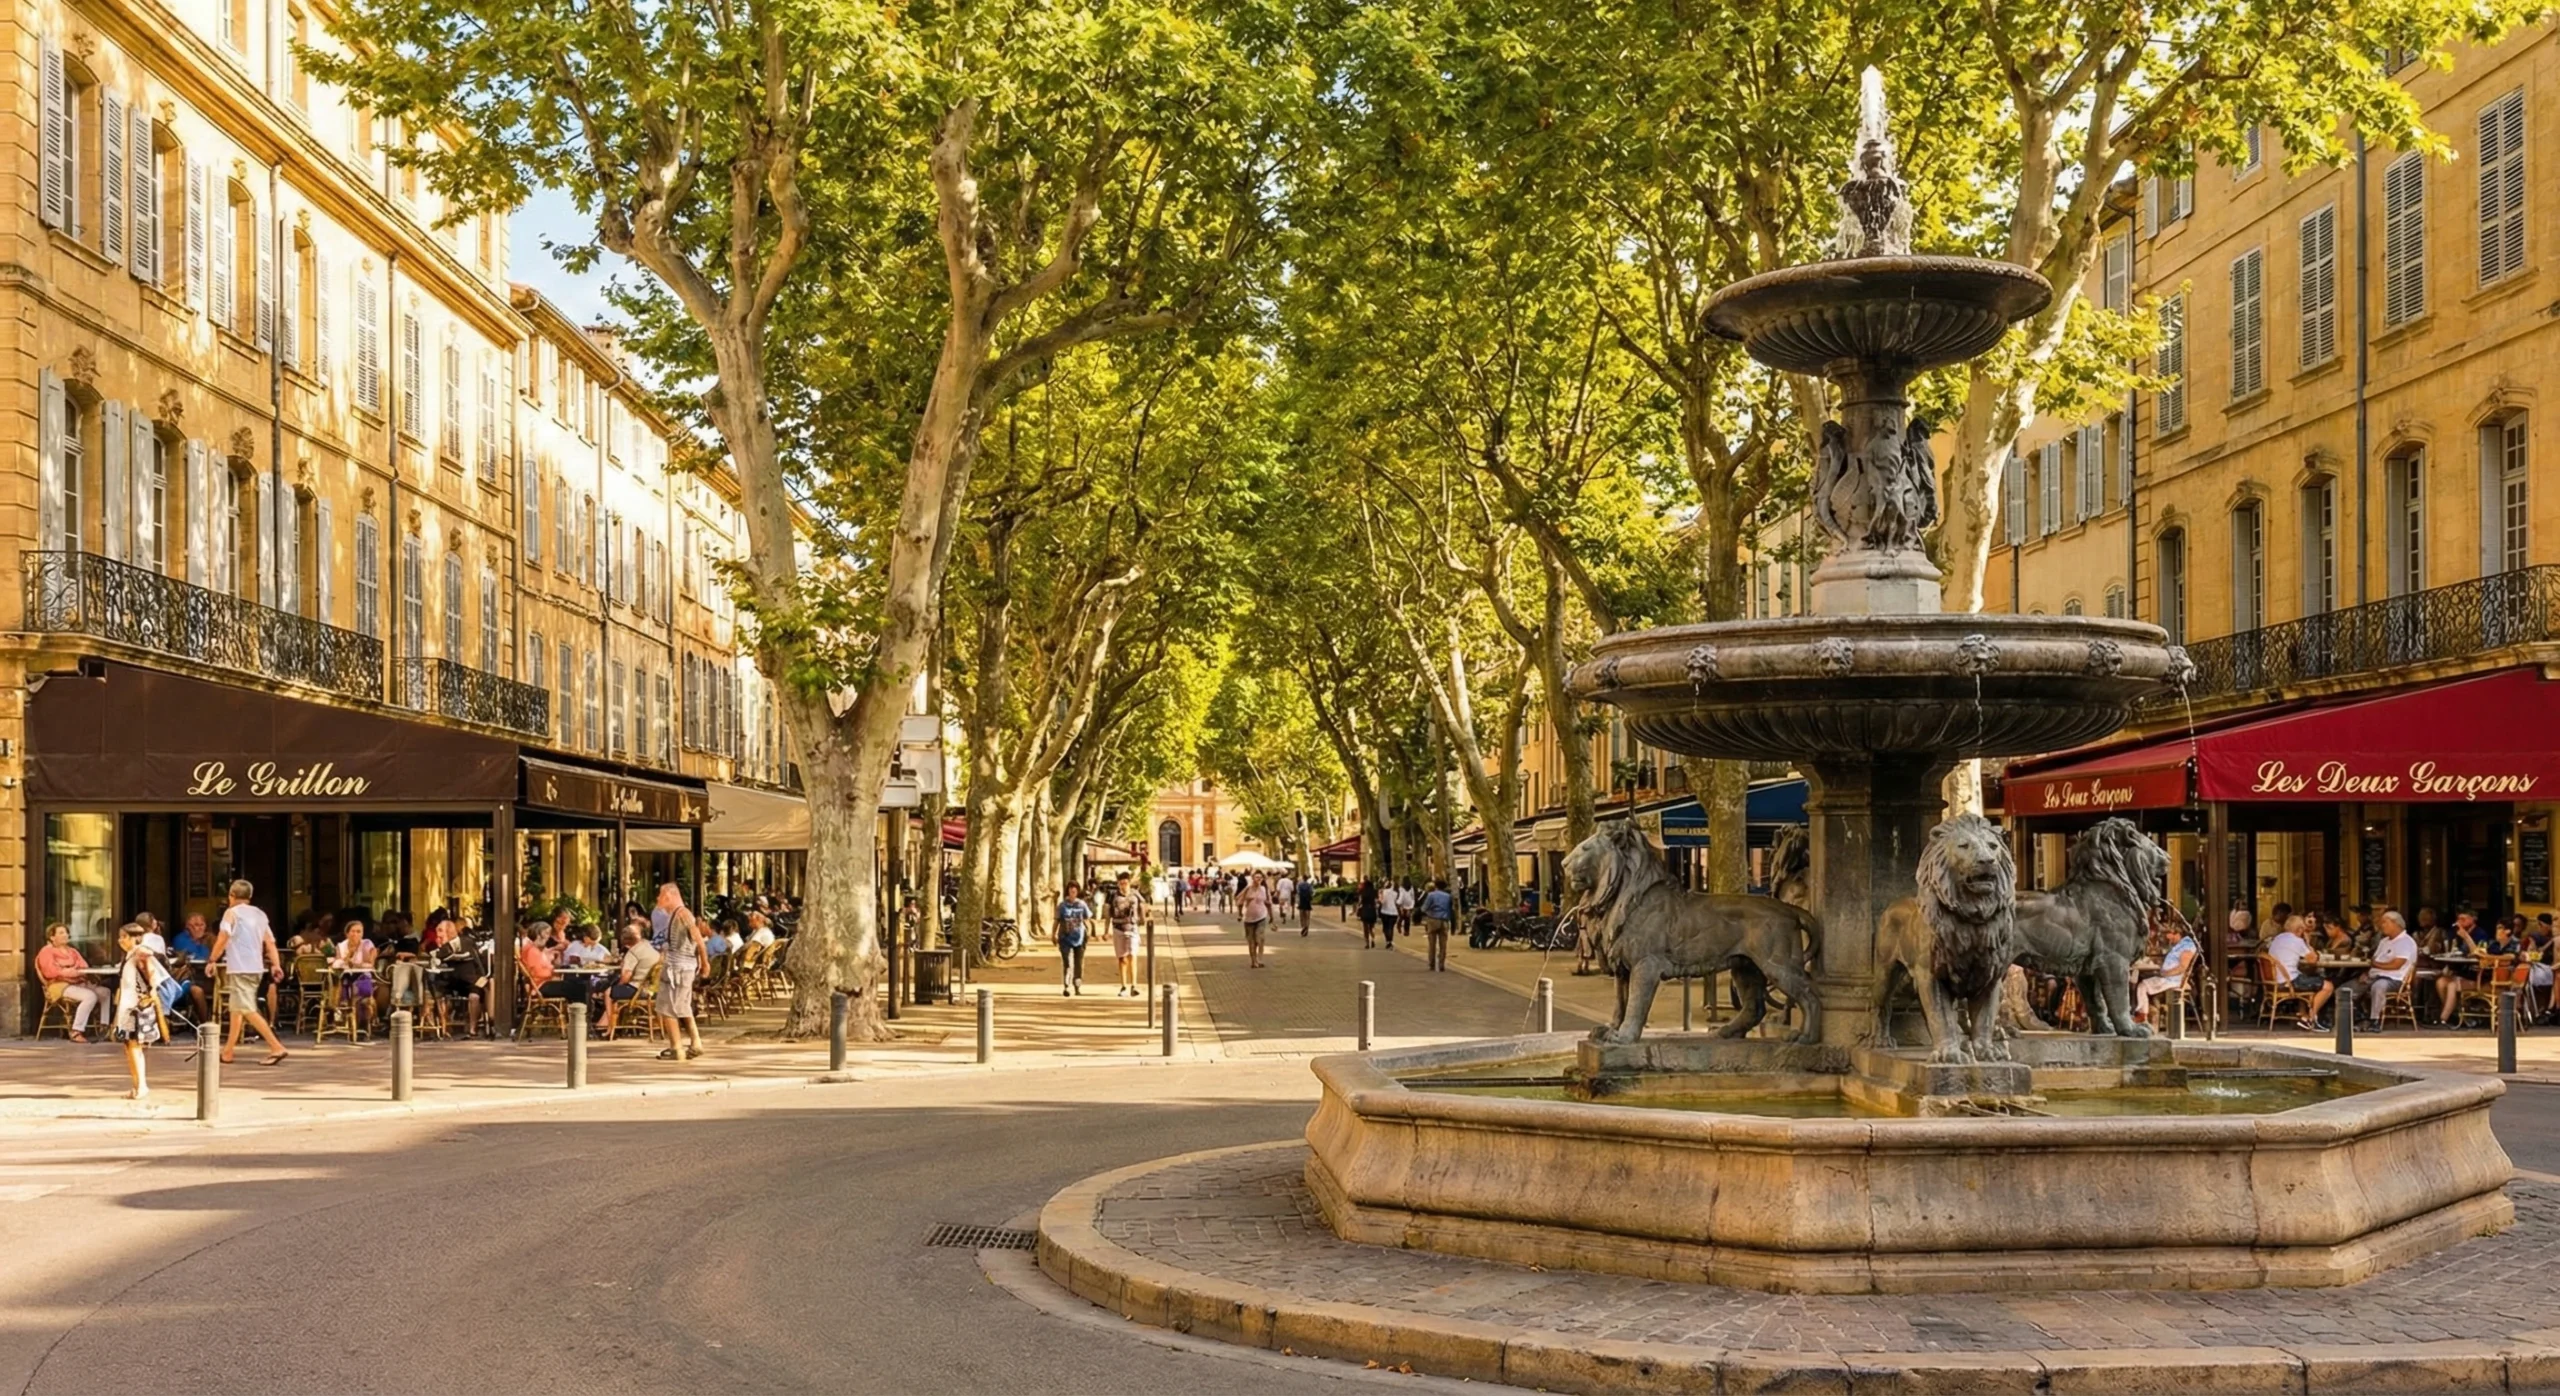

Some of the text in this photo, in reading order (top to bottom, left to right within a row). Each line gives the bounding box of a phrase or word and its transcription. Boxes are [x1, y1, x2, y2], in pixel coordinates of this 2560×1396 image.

[187, 762, 371, 796] Le Grillon
[2252, 761, 2539, 801] Les Deux Garçons
